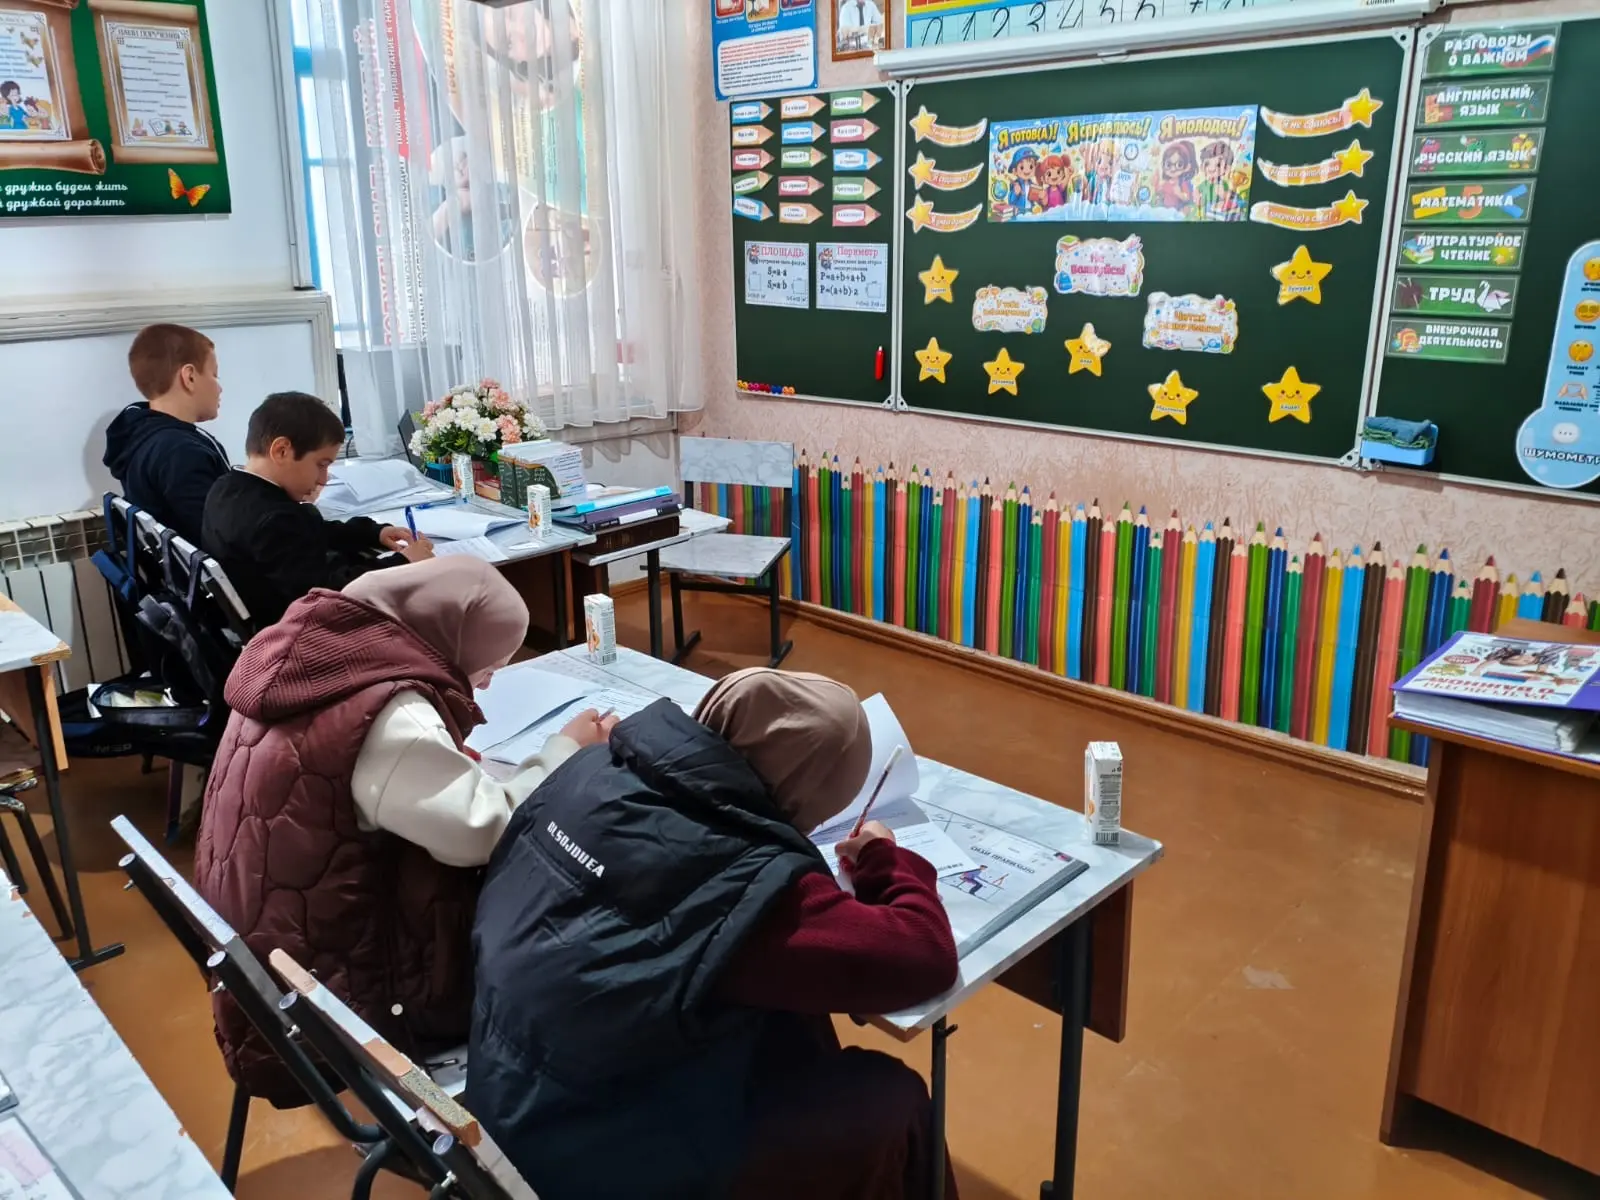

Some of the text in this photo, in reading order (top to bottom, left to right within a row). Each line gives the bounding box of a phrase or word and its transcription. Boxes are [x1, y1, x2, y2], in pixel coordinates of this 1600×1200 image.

[1444, 33, 1532, 53] РАЗГОВОРЫ
[1448, 51, 1528, 66] О ВАЖНОМ
[1437, 84, 1531, 104] АНГЛИЙСКИЙ
[1460, 103, 1500, 116] ЯЗЫК
[998, 130, 1009, 149] Я
[1067, 122, 1080, 146] Я
[1160, 115, 1176, 143] Я
[1176, 115, 1248, 141] молодец!
[1419, 147, 1530, 164] РУССКИЙ ЯЗЫК
[5, 181, 128, 195] дружно будем жить
[6, 197, 126, 212] дружбой дорожить
[1420, 195, 1514, 208] МАТЕМАТИКА
[1417, 235, 1521, 247] ЛИТЕРАТУРНОЕ
[761, 246, 804, 258] ПЛОЩАДЬ
[1440, 250, 1490, 261] ЧТЕНИЕ
[1429, 286, 1476, 303] ТРУД
[1425, 325, 1499, 337] ВНЕУРОЧНАЯ
[1418, 335, 1503, 349] ДЕЯТЕЛЬНОСТЬ
